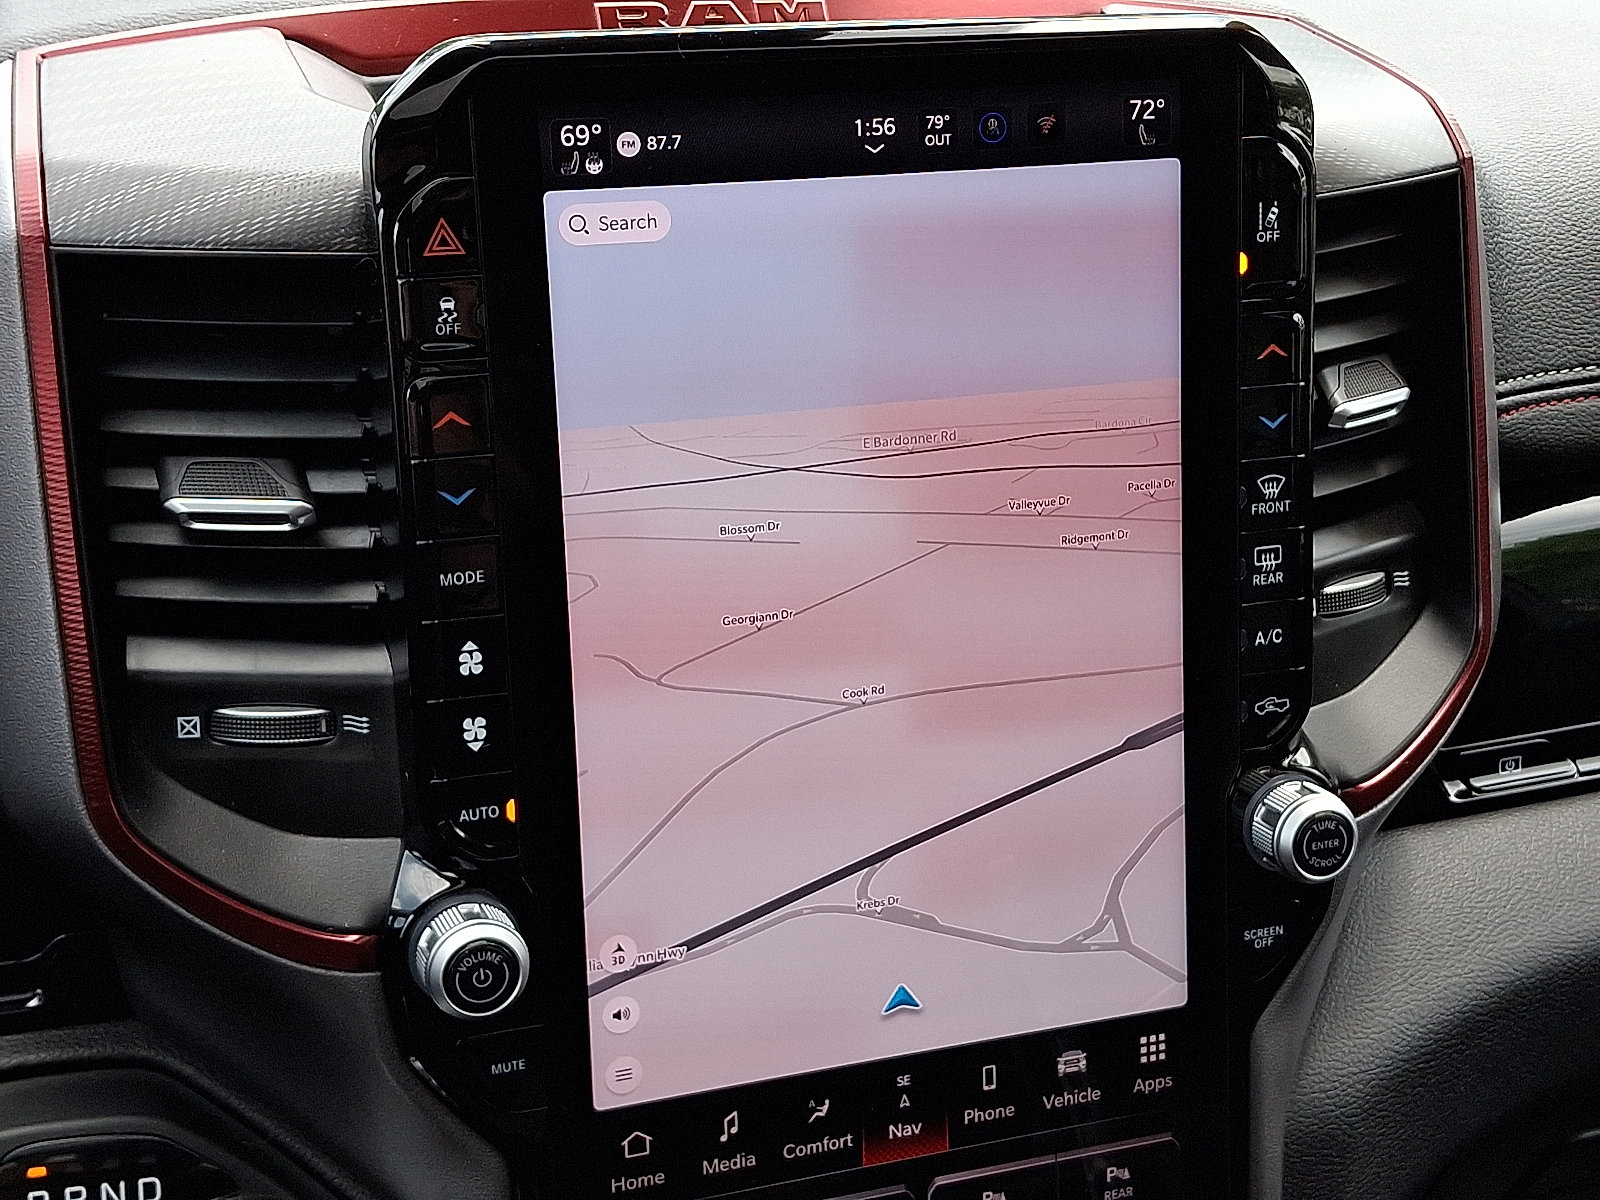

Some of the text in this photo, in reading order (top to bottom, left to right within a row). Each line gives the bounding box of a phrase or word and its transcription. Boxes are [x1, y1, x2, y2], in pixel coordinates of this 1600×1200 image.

[593, 0, 829, 30] RAM
[1129, 98, 1165, 121] 72°
[854, 117, 896, 137] 1:56
[925, 114, 950, 130] 79°
[560, 124, 602, 147] 69°
[621, 134, 682, 151] FM 87.7
[924, 133, 952, 147] OUT
[598, 213, 658, 232] Search
[1256, 230, 1281, 243] OFF
[435, 323, 461, 335] OFF
[863, 429, 957, 449] E Bardonner Rd
[1127, 478, 1176, 493] Pacella Dr
[1008, 495, 1071, 512] Valleyvue Dr
[1251, 500, 1292, 516] FRONT
[719, 521, 782, 537] Blossom Dr
[1061, 529, 1129, 546] Ridgemont Dr
[439, 569, 486, 587] MODE
[1252, 572, 1284, 586] REAR
[722, 609, 795, 627] Georgiann Dr
[1255, 628, 1283, 647] A/C
[841, 685, 886, 700] Cook Rd
[459, 805, 500, 823] AUTO
[1311, 820, 1338, 833] TUNE
[1312, 839, 1340, 850] ENTER
[1309, 854, 1341, 867] SCROLL
[856, 896, 900, 910] Krebs Dr
[1243, 925, 1284, 941] SCREEN
[1254, 936, 1275, 949] OFF
[457, 951, 503, 972] VOLUME
[611, 955, 626, 967] 3D
[657, 947, 686, 960] Hwy
[491, 1058, 526, 1075] MUTE
[896, 1074, 911, 1087] SE
[1132, 1075, 1173, 1095] Apps
[1043, 1087, 1101, 1110] Vehicle
[964, 1104, 1016, 1125] Phone
[888, 1122, 923, 1140] Nav
[783, 1132, 854, 1159] Comfort
[702, 1152, 757, 1176] Media
[611, 1171, 666, 1194] Home
[1104, 1186, 1134, 1200] REAR
